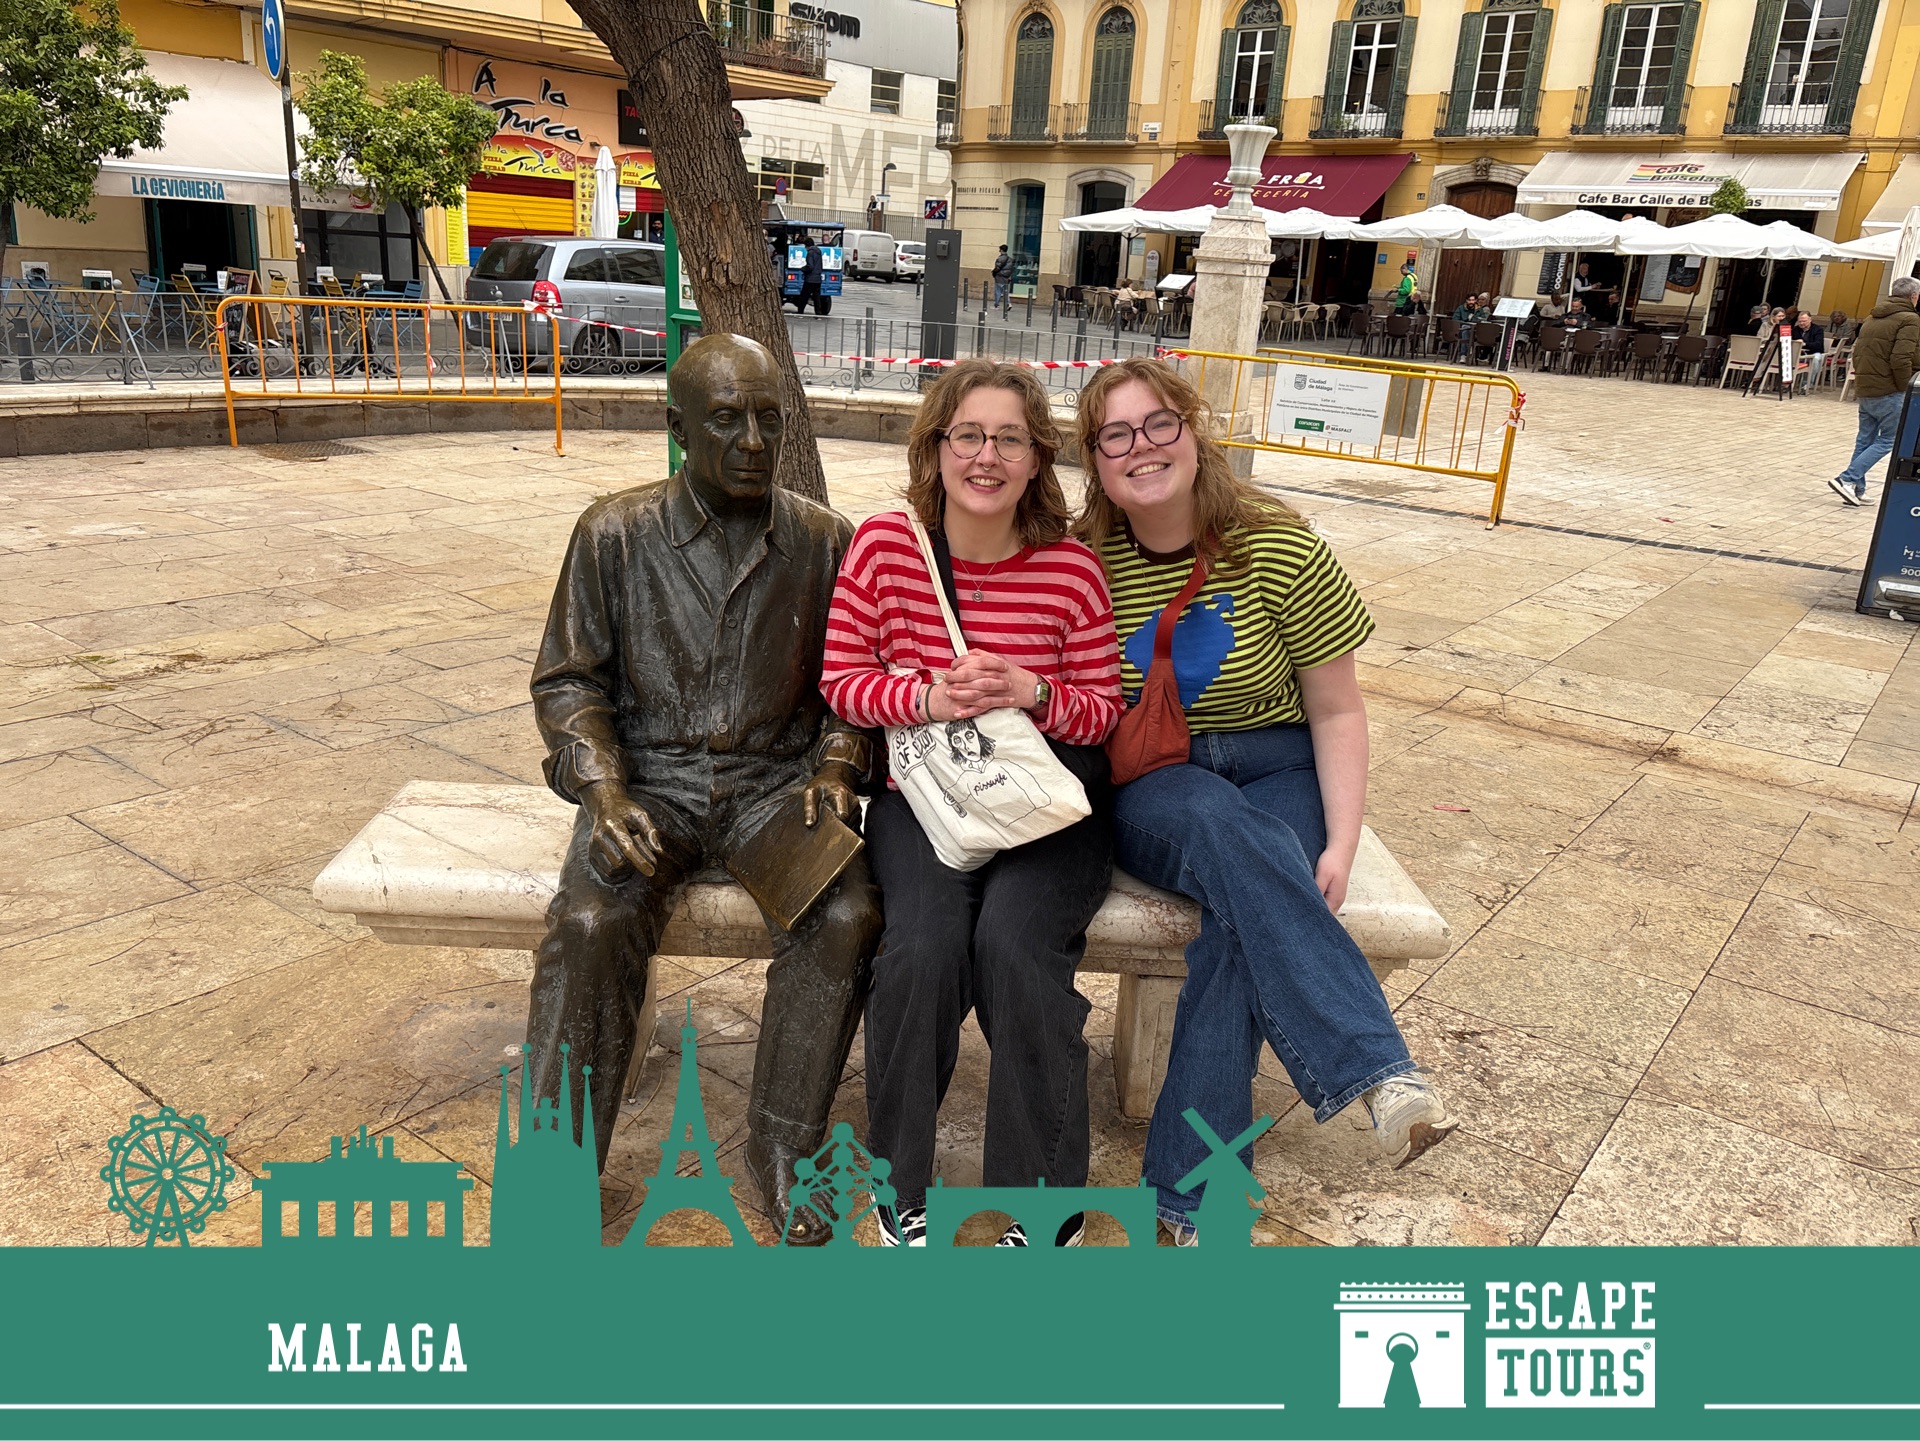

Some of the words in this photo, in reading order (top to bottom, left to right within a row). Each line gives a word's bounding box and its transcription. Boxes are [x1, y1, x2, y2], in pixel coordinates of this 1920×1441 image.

[473, 60, 497, 96] A
[540, 77, 570, 109] la
[486, 97, 584, 144] Turca
[763, 134, 791, 160] DE
[799, 138, 825, 164] LA
[504, 156, 561, 174] Turca
[131, 176, 149, 195] LA
[302, 194, 338, 204] ÁLAGA
[1578, 193, 1608, 204] Cafe
[1611, 193, 1635, 204] Bar
[1639, 194, 1674, 205] Calle
[1677, 195, 1695, 206] de
